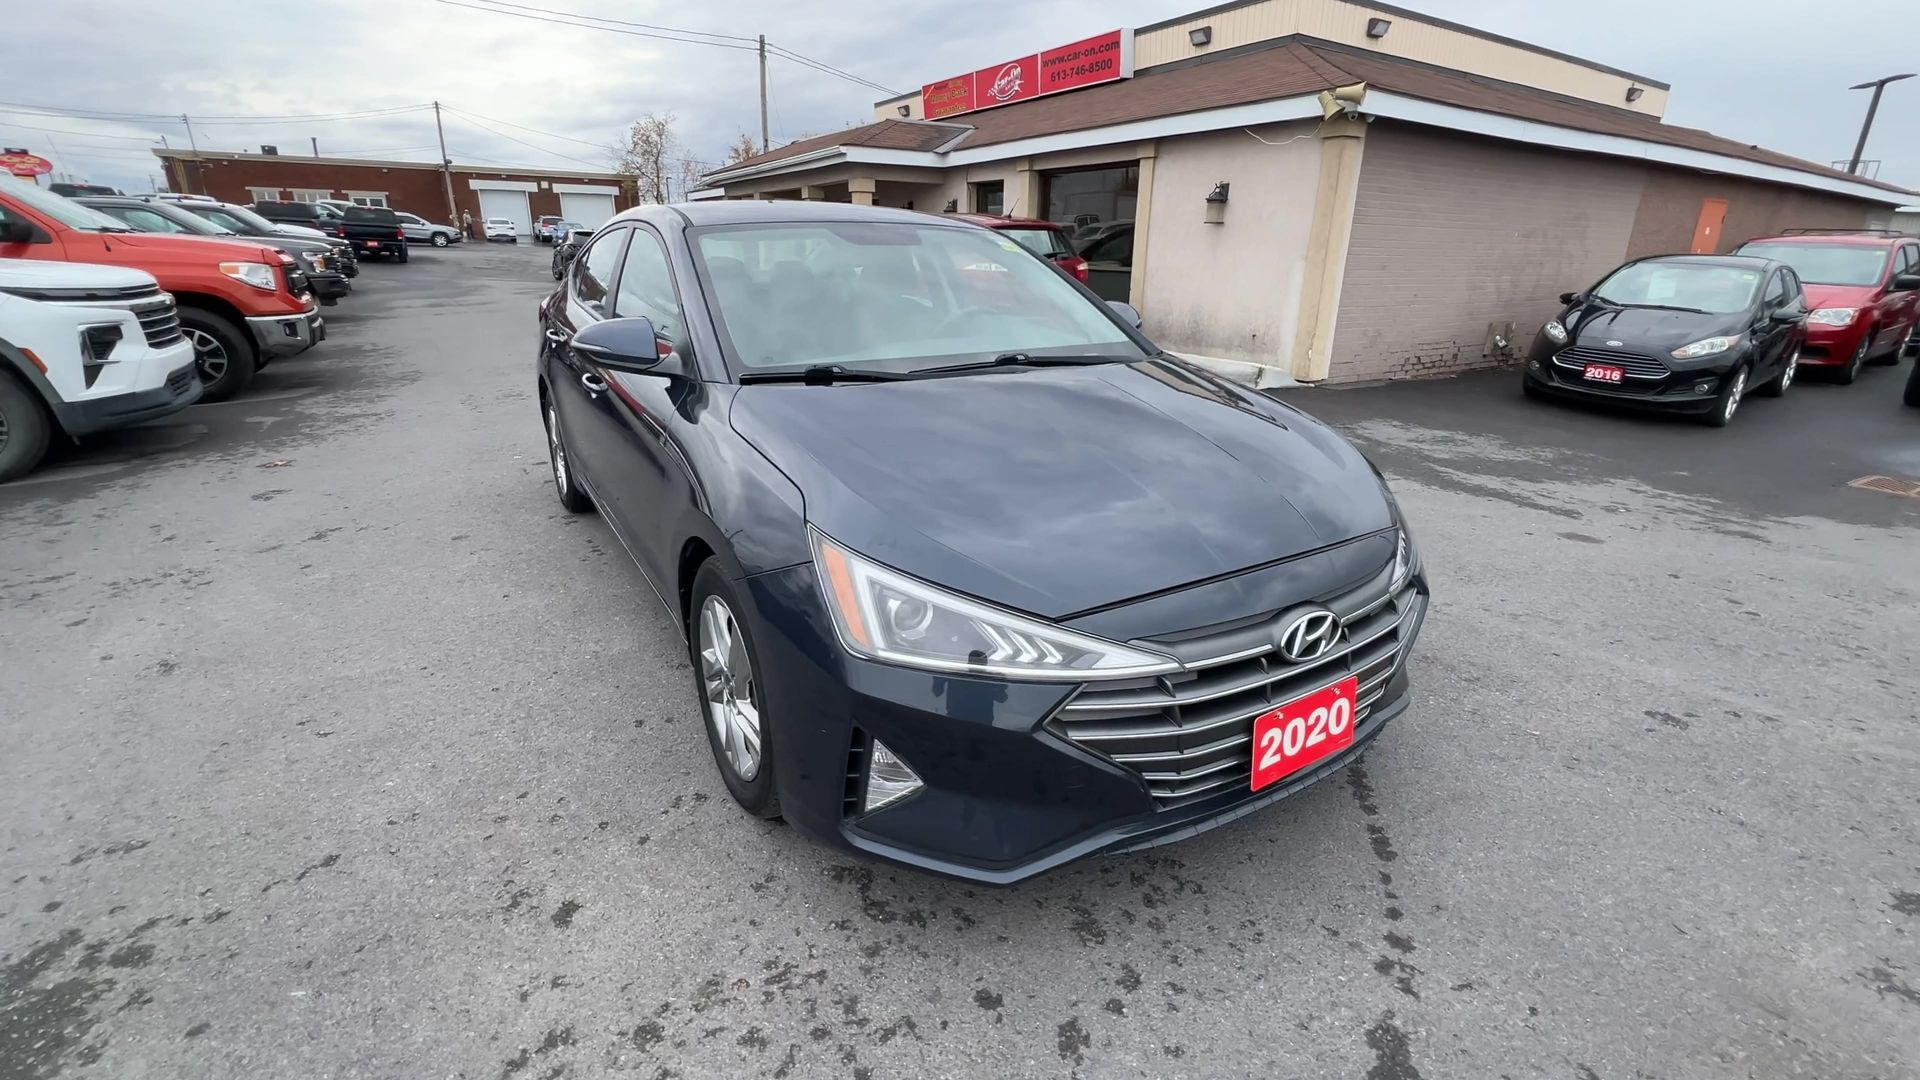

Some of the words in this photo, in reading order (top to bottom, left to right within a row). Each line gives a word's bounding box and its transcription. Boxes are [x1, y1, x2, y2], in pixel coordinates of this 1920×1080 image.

[1042, 41, 1119, 68] www.car-on.com
[1050, 58, 1113, 82] 613-746-8500
[1585, 367, 1621, 380] 2016
[1259, 697, 1350, 771] 2020
